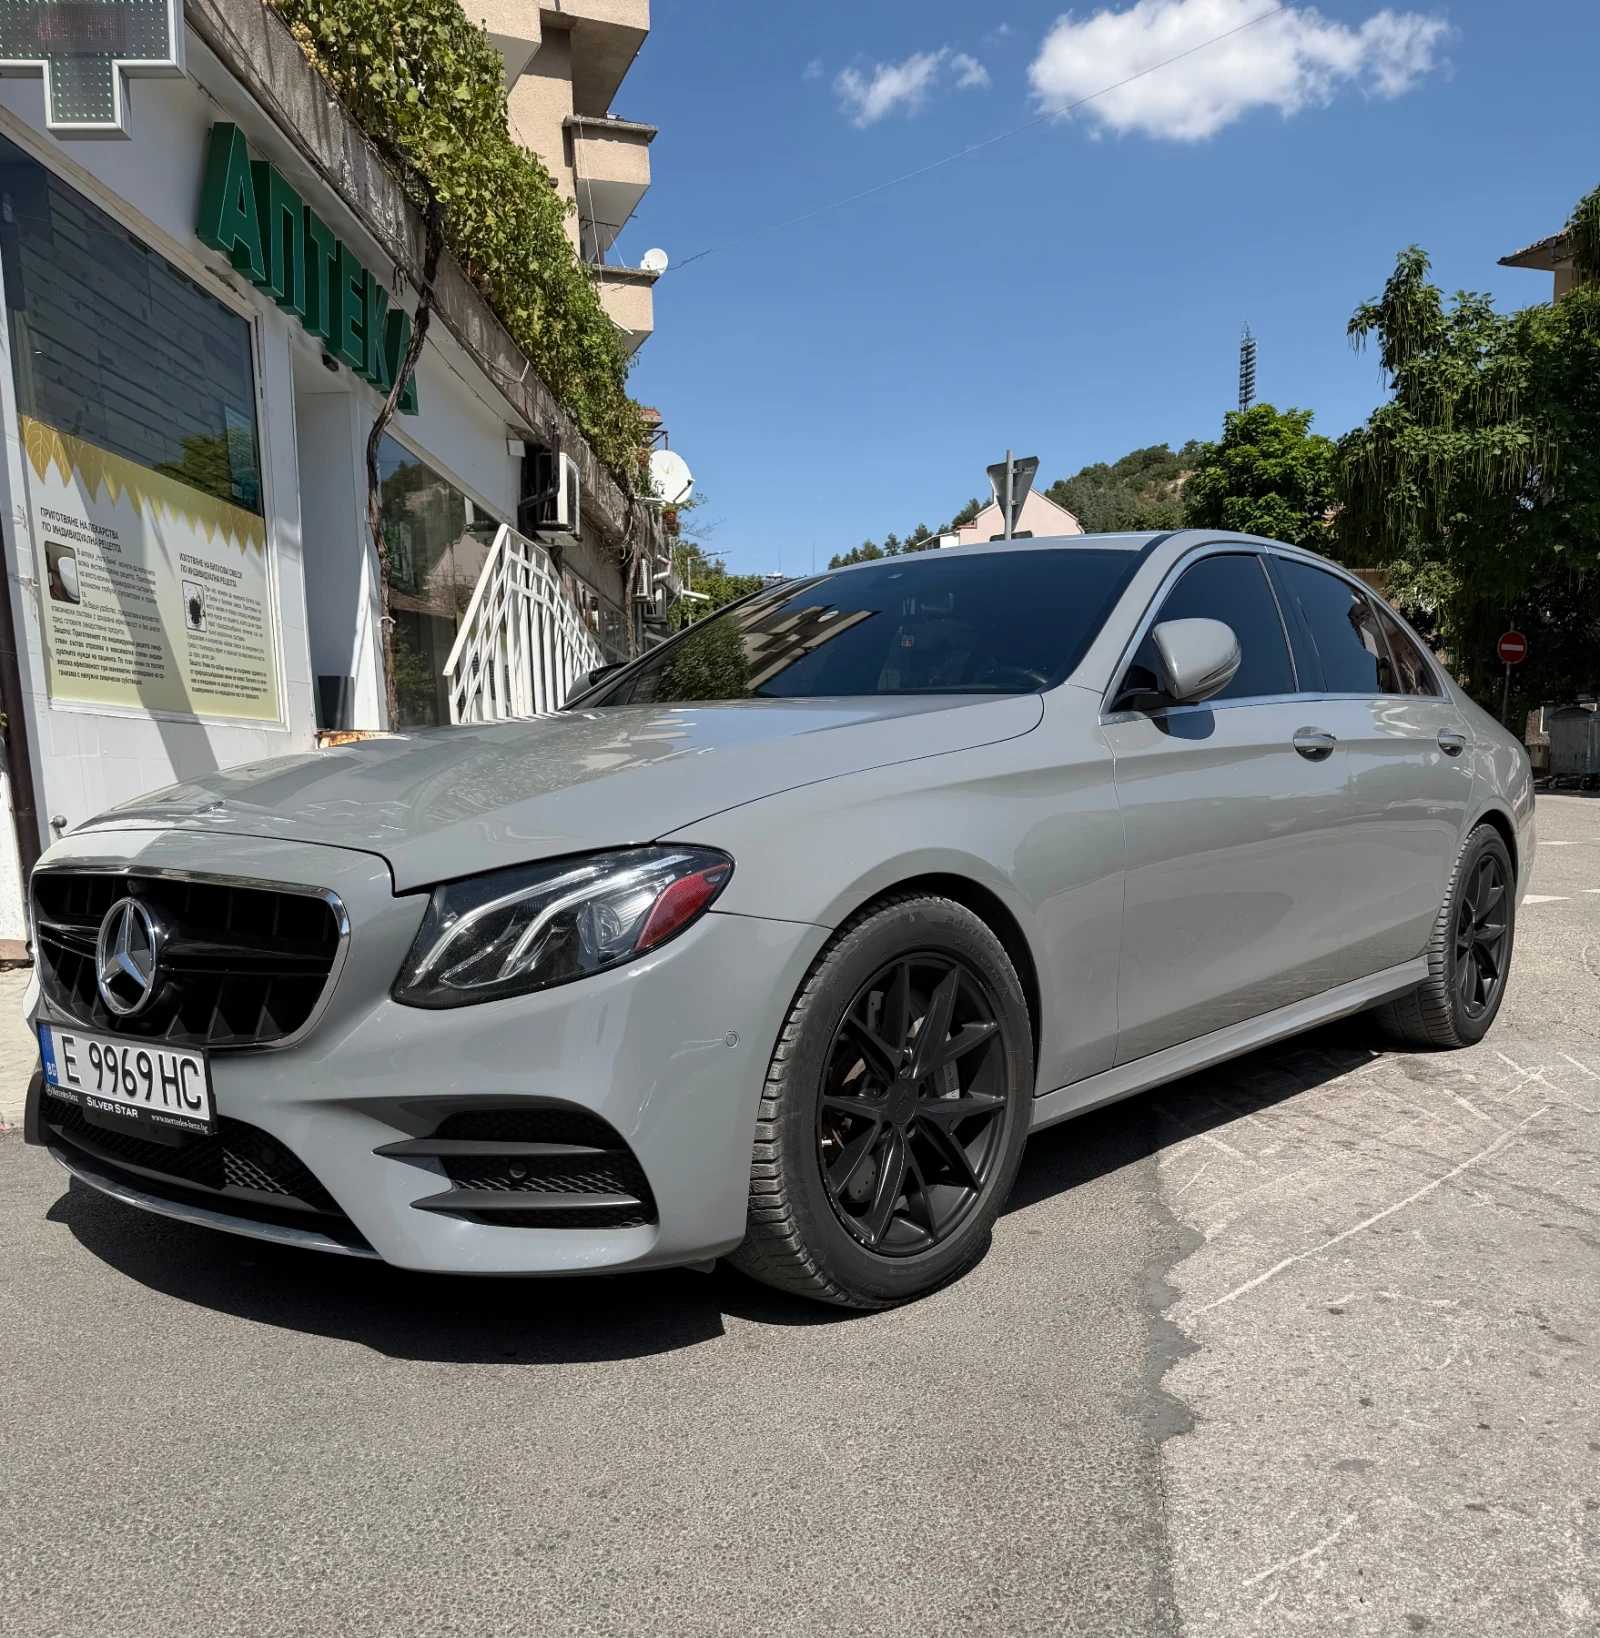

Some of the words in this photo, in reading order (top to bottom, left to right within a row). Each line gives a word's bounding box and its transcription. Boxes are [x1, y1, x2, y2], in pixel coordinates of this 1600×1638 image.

[197, 122, 418, 415] АПТЕКА
[40, 507, 78, 528] ПРИГОТВЯНЕ
[79, 520, 87, 530] НА
[88, 523, 119, 540] ЛЕКАРСТВА
[42, 521, 51, 532] ПО
[53, 525, 98, 546] ИНДИВИДУАЛНА
[99, 539, 122, 553] РЕЦЕПТА
[181, 564, 187, 573] ПО
[220, 576, 237, 588] РЕЦЕПТА
[204, 561, 210, 569] НА
[47, 1062, 57, 1077] BG
[62, 1034, 82, 1085] E
[88, 1040, 154, 1102] 9969
[158, 1053, 202, 1110] HC
[86, 1096, 114, 1112] SILVER
[114, 1104, 139, 1118] STAR
[151, 1114, 209, 1134] www.mercedes-benz.bg
